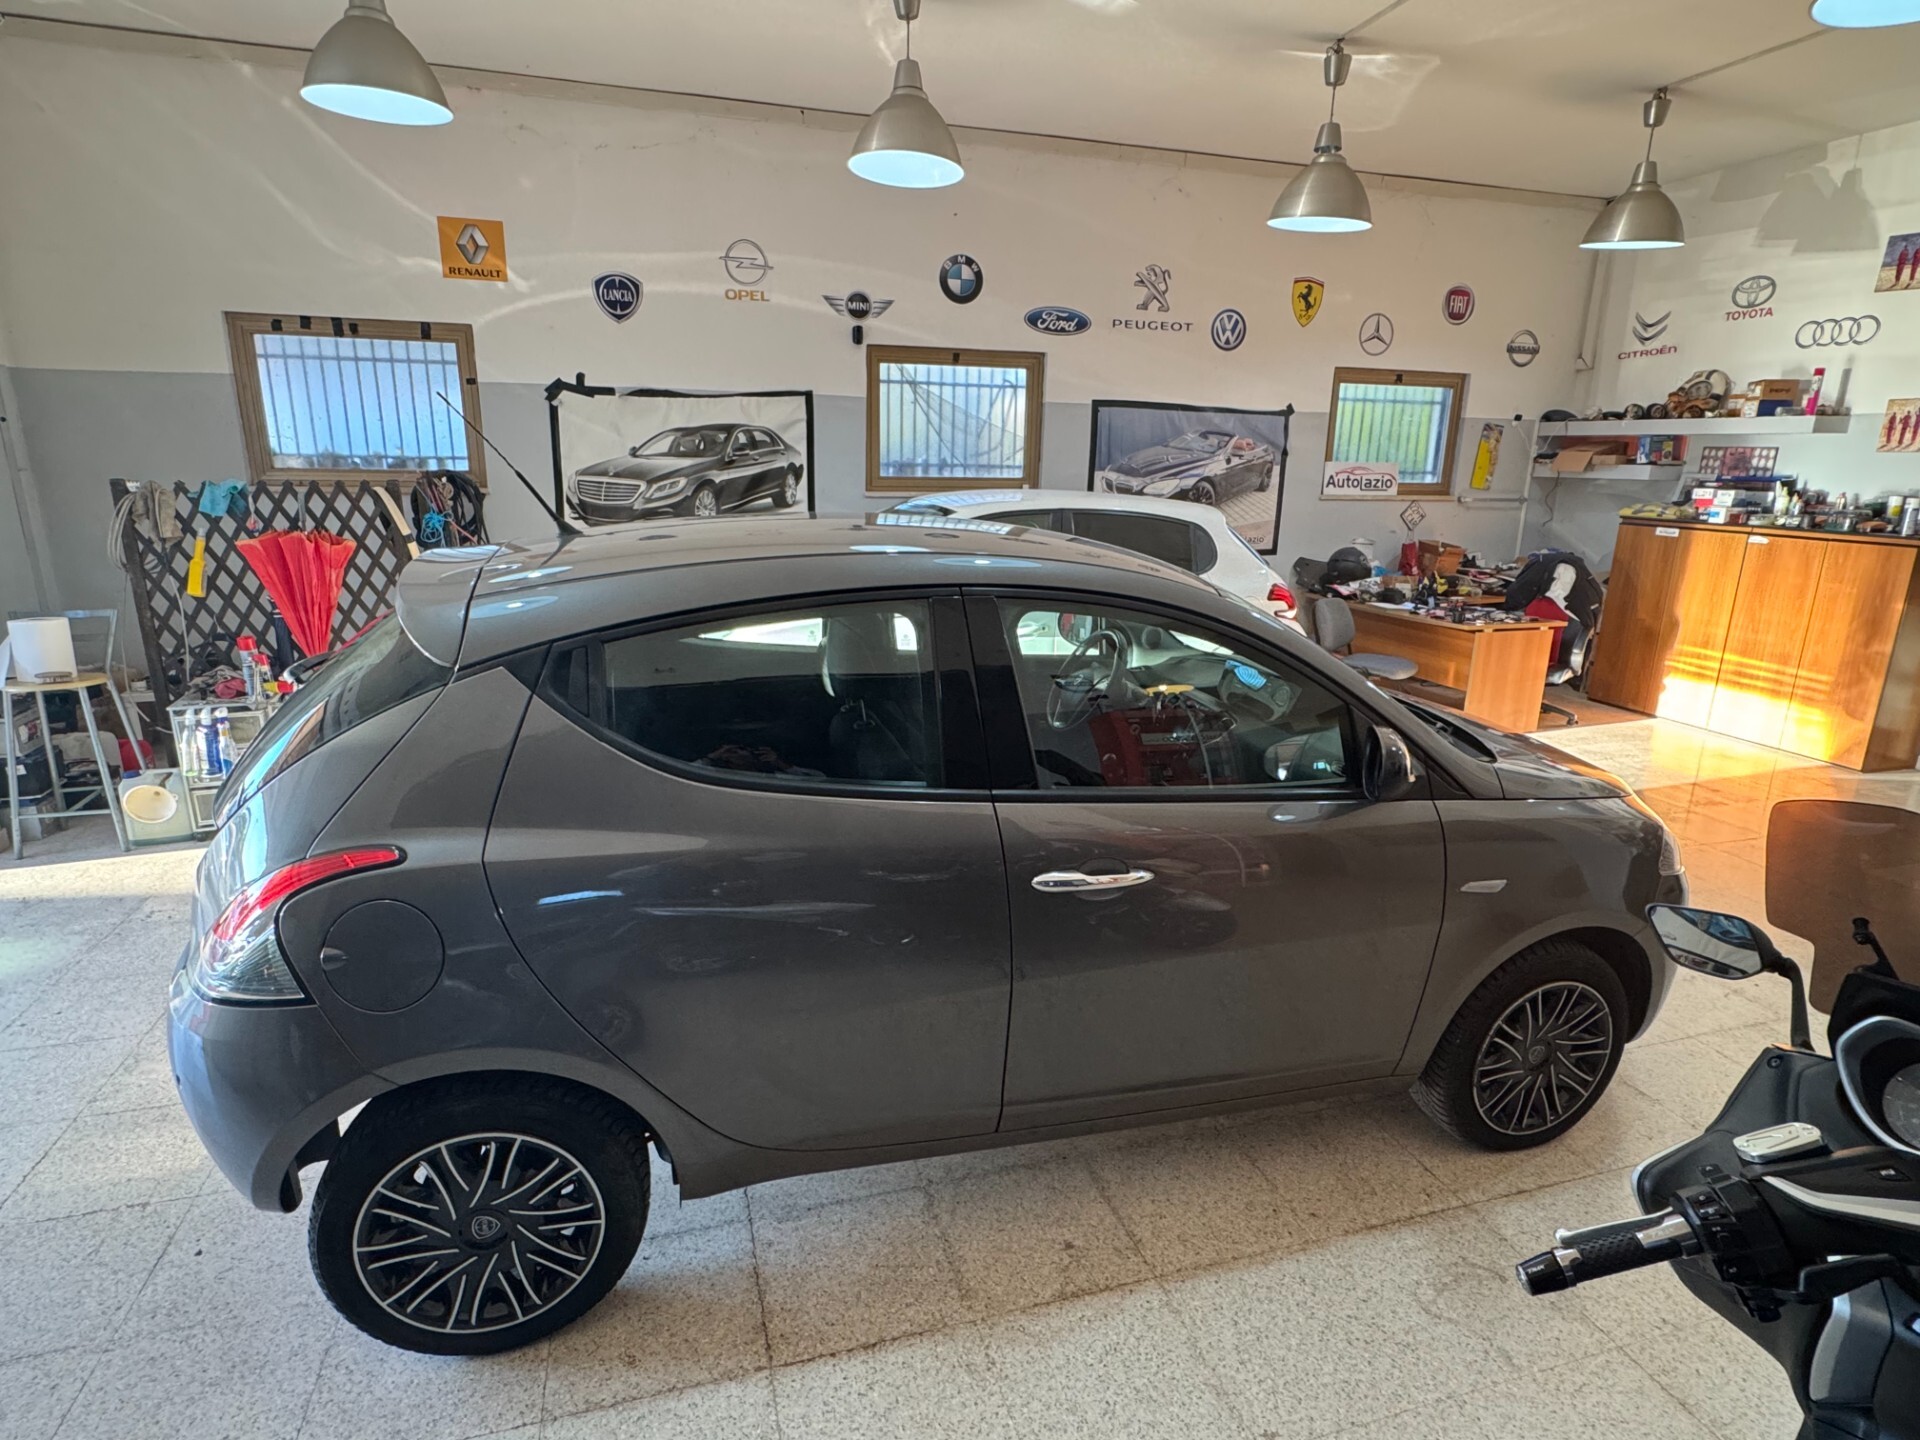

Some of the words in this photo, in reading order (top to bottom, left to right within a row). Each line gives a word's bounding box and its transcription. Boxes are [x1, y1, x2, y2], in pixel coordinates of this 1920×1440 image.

[944, 255, 980, 272] BMW
[448, 263, 503, 279] RENAULT
[603, 288, 634, 303] LANCIA
[725, 289, 769, 302] OPEL
[848, 300, 870, 312] MINI
[1449, 294, 1470, 314] FIAT
[1036, 310, 1077, 332] Ford
[1725, 307, 1773, 321] TOYOTA
[1112, 318, 1194, 332] PEUGEOT
[1508, 344, 1538, 354] NISSAN
